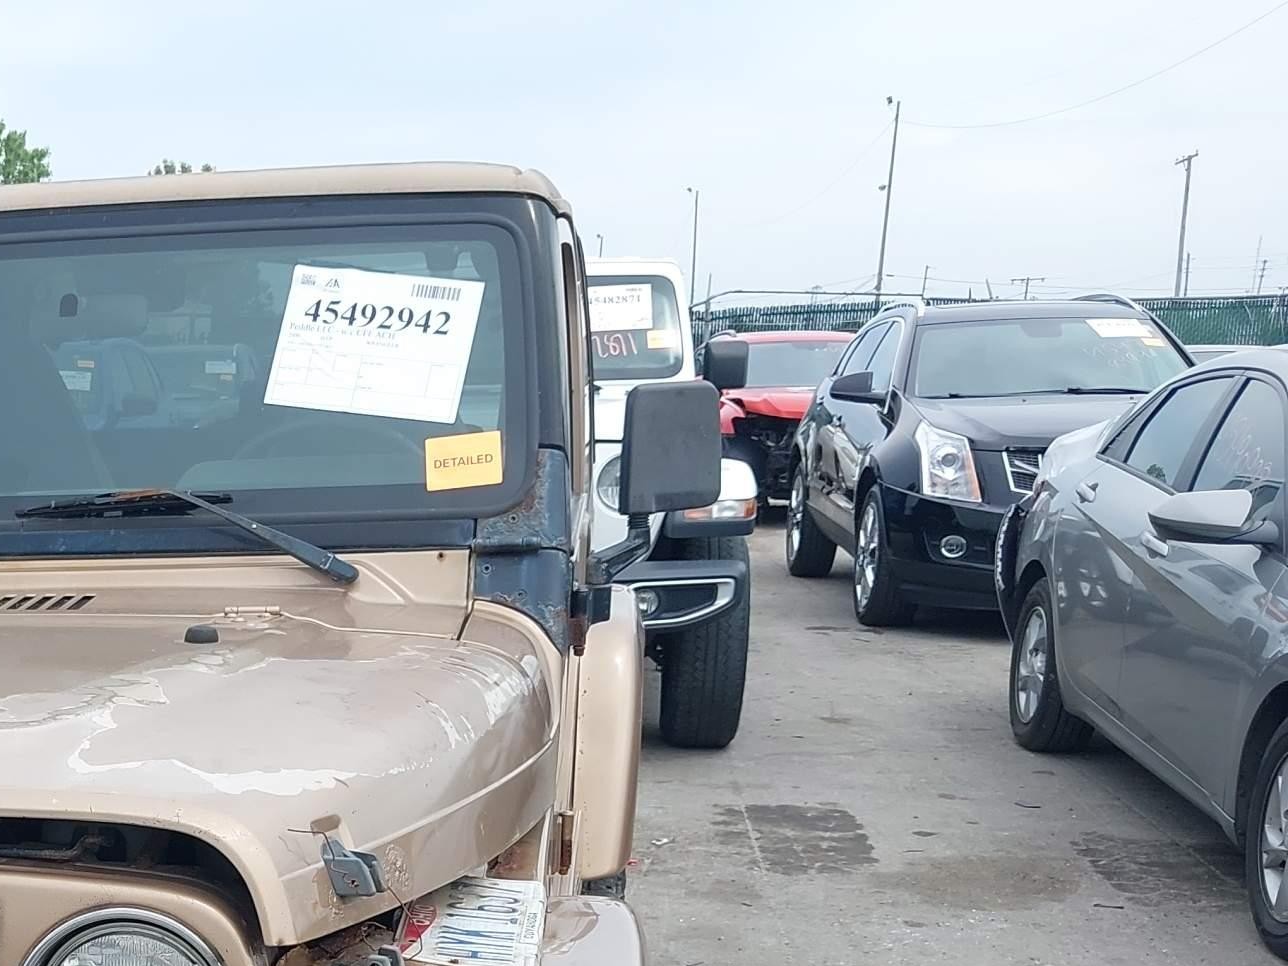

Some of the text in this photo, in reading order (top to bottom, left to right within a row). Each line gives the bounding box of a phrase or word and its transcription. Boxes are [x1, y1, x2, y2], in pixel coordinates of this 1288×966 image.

[304, 298, 451, 336] 45492942
[433, 452, 494, 471] DETAILED
[410, 903, 437, 926] OHIO
